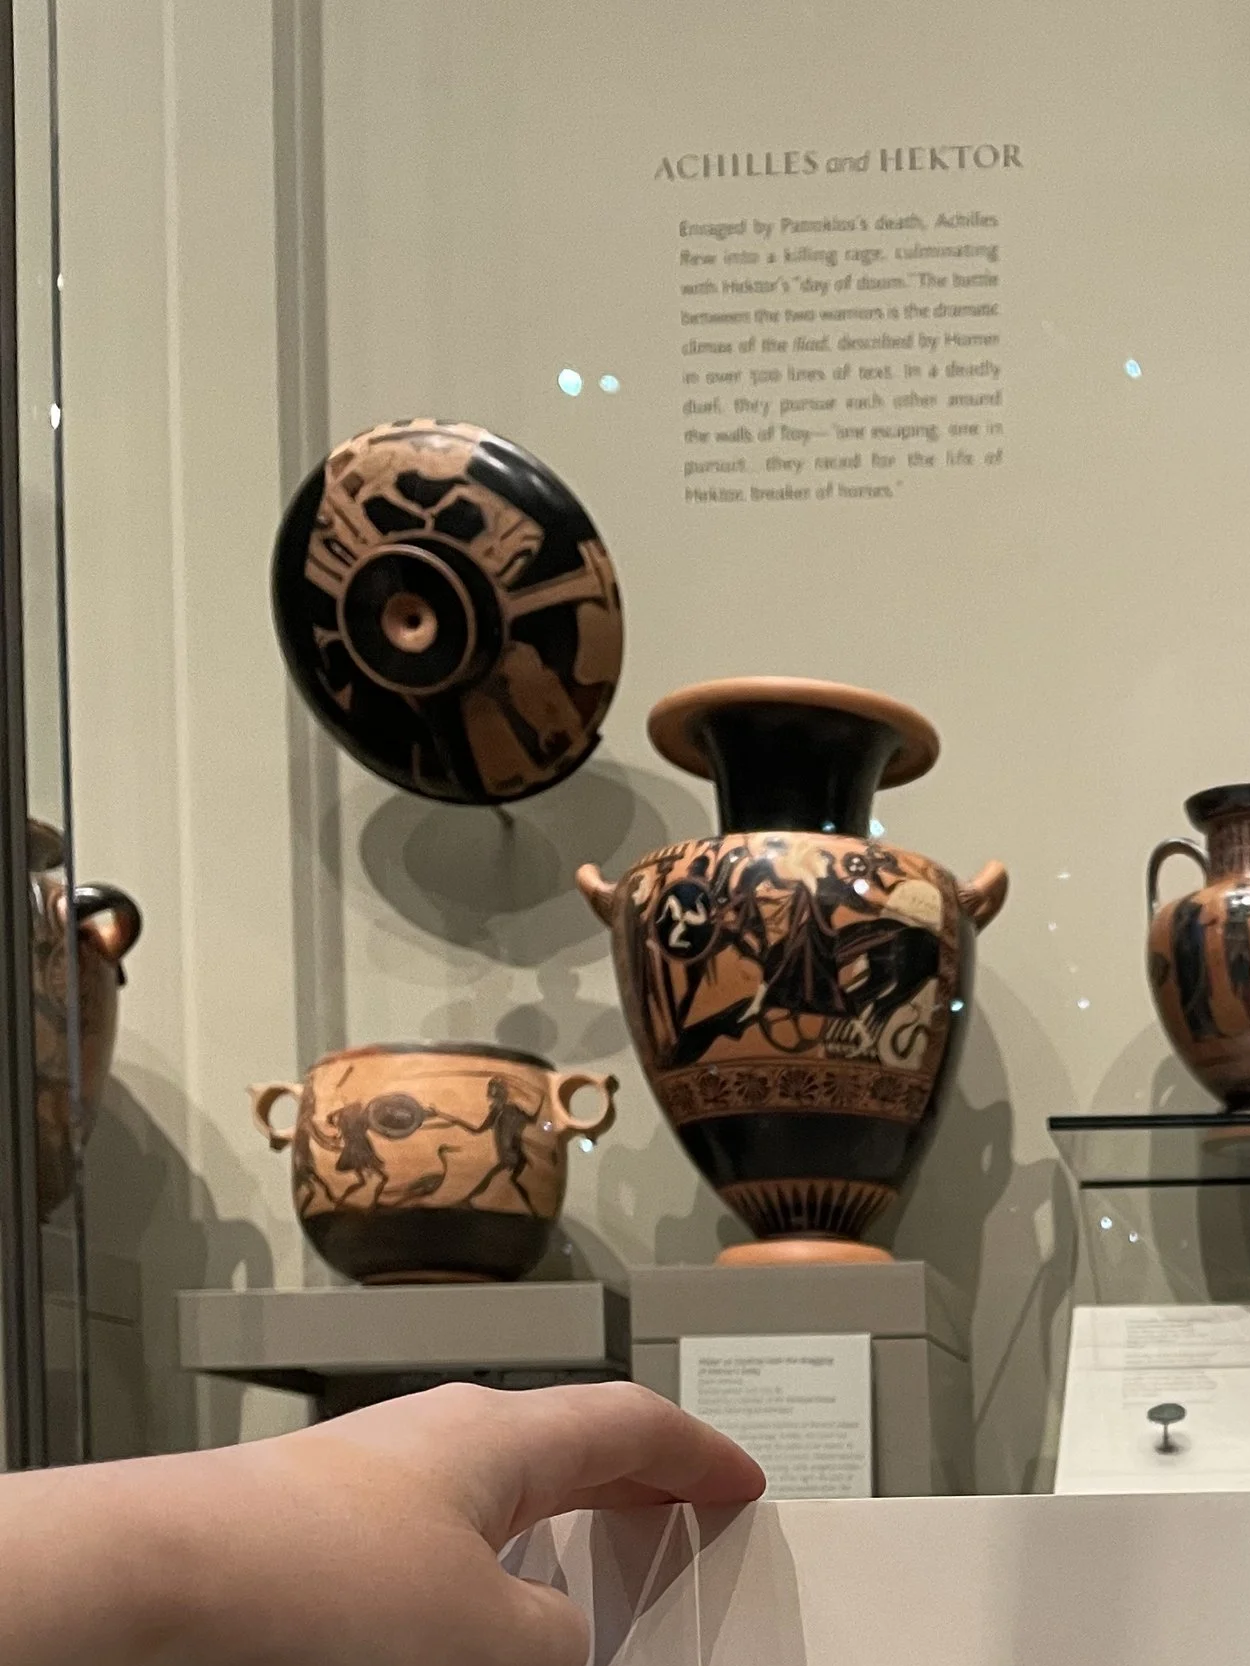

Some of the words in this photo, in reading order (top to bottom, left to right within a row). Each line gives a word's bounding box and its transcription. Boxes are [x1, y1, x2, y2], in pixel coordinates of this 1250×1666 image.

[653, 150, 819, 183] ACHILLES
[825, 150, 871, 174] and
[879, 143, 1024, 173] HEKTOR
